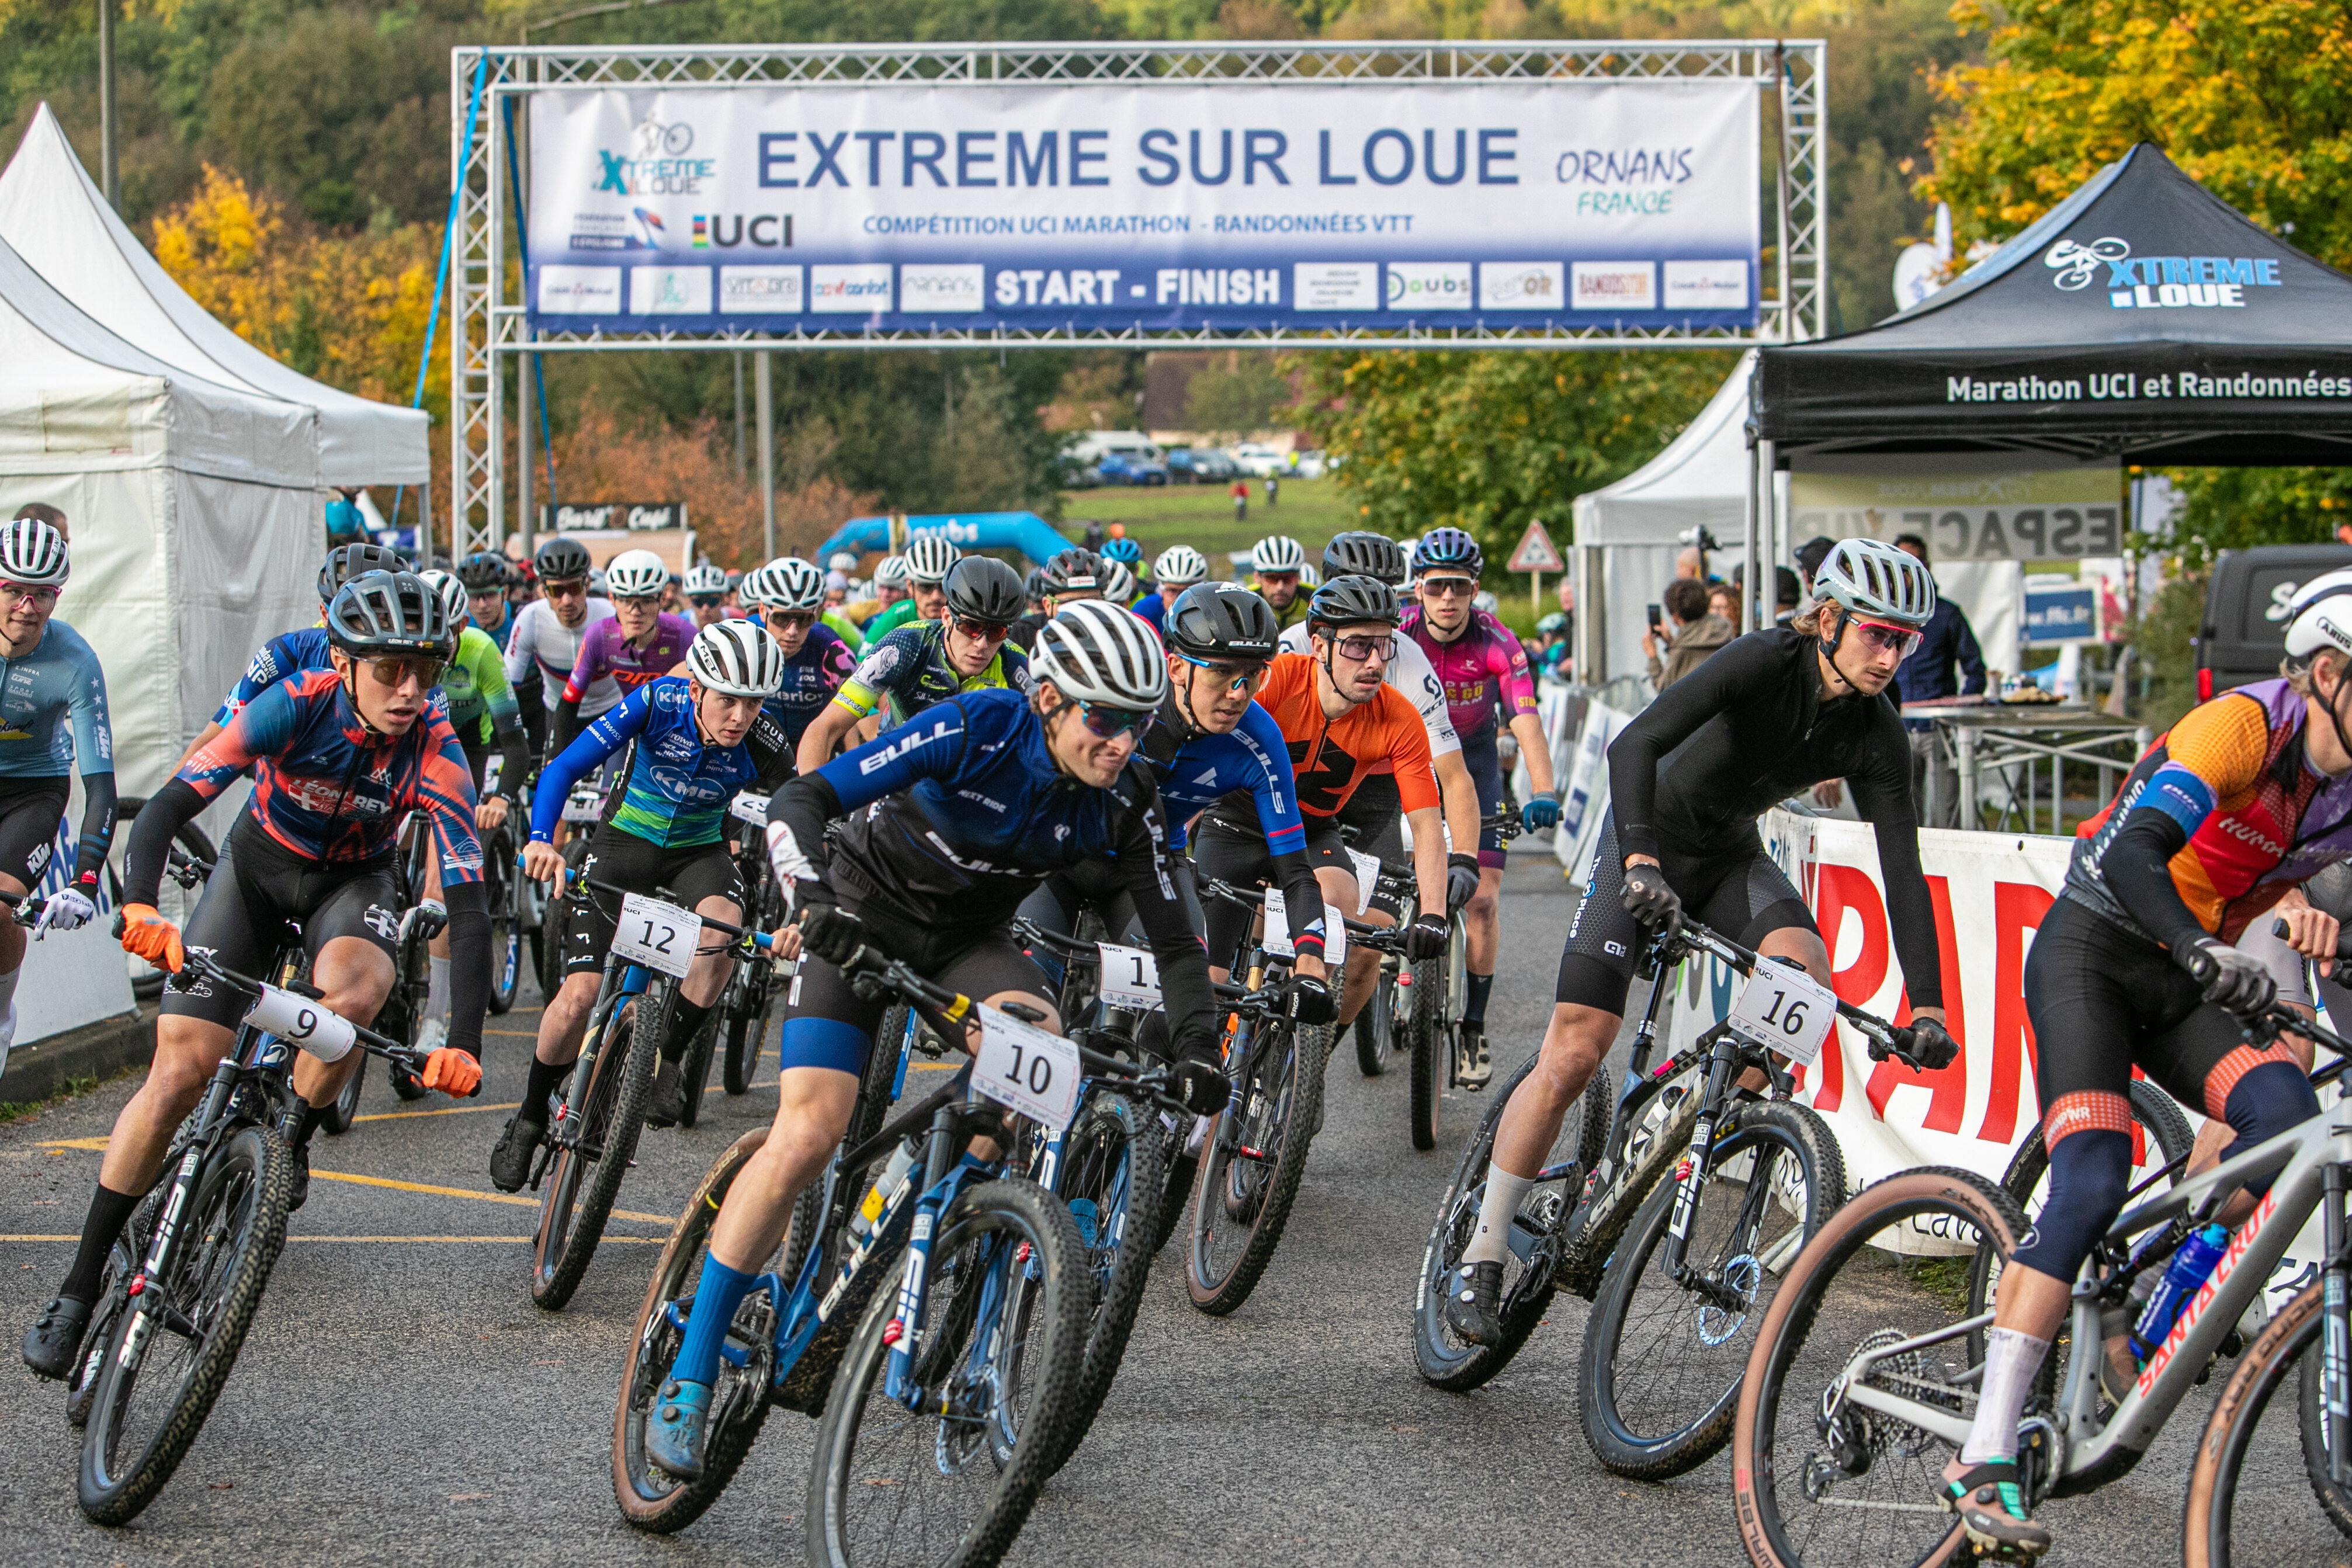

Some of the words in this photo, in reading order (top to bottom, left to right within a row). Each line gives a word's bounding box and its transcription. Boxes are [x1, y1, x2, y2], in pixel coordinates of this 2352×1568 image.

[758, 131, 1111, 187] EXTREME
[1136, 129, 1292, 186] SUR
[1319, 127, 1519, 186] LOUE
[1556, 147, 1694, 185] ORNANS
[1577, 190, 1674, 216] FRANCE
[711, 214, 794, 248] UCI
[863, 214, 1014, 234] COMPÉTITION
[1021, 217, 1057, 234] UCI
[1063, 215, 1190, 233] MARATHON
[1215, 211, 1366, 233] RANDONNÉES
[1375, 215, 1414, 233] VTT
[995, 269, 1121, 305] START
[1156, 269, 1280, 304] FINISH
[2107, 256, 2281, 288] XTREME
[2134, 284, 2246, 308] LOUE
[1947, 376, 2082, 401] Marathon
[2089, 373, 2136, 400] UCI
[2143, 374, 2171, 398] et
[2178, 369, 2351, 398] Randonnées
[700, 644, 720, 675] MET
[98, 725, 110, 759] KTM
[757, 716, 785, 743] TRUE
[654, 769, 720, 801] KMC
[1229, 728, 1286, 814] BULLS
[292, 779, 345, 801] LÉON
[353, 795, 392, 815] REY
[958, 789, 984, 802] NEXT
[983, 797, 1008, 814] RIDE
[27, 842, 51, 875] KTM
[1588, 855, 1602, 881] The
[639, 920, 676, 955] 12
[1758, 969, 1774, 981] UCI
[1290, 992, 1299, 1018] ERGON
[1761, 990, 1810, 1036] 16
[288, 1007, 318, 1039] 9
[1005, 1043, 1052, 1095] 10
[818, 1177, 913, 1323] BULLS
[2138, 1280, 2218, 1399] SANTA
[2214, 1188, 2277, 1285] CRUZ
